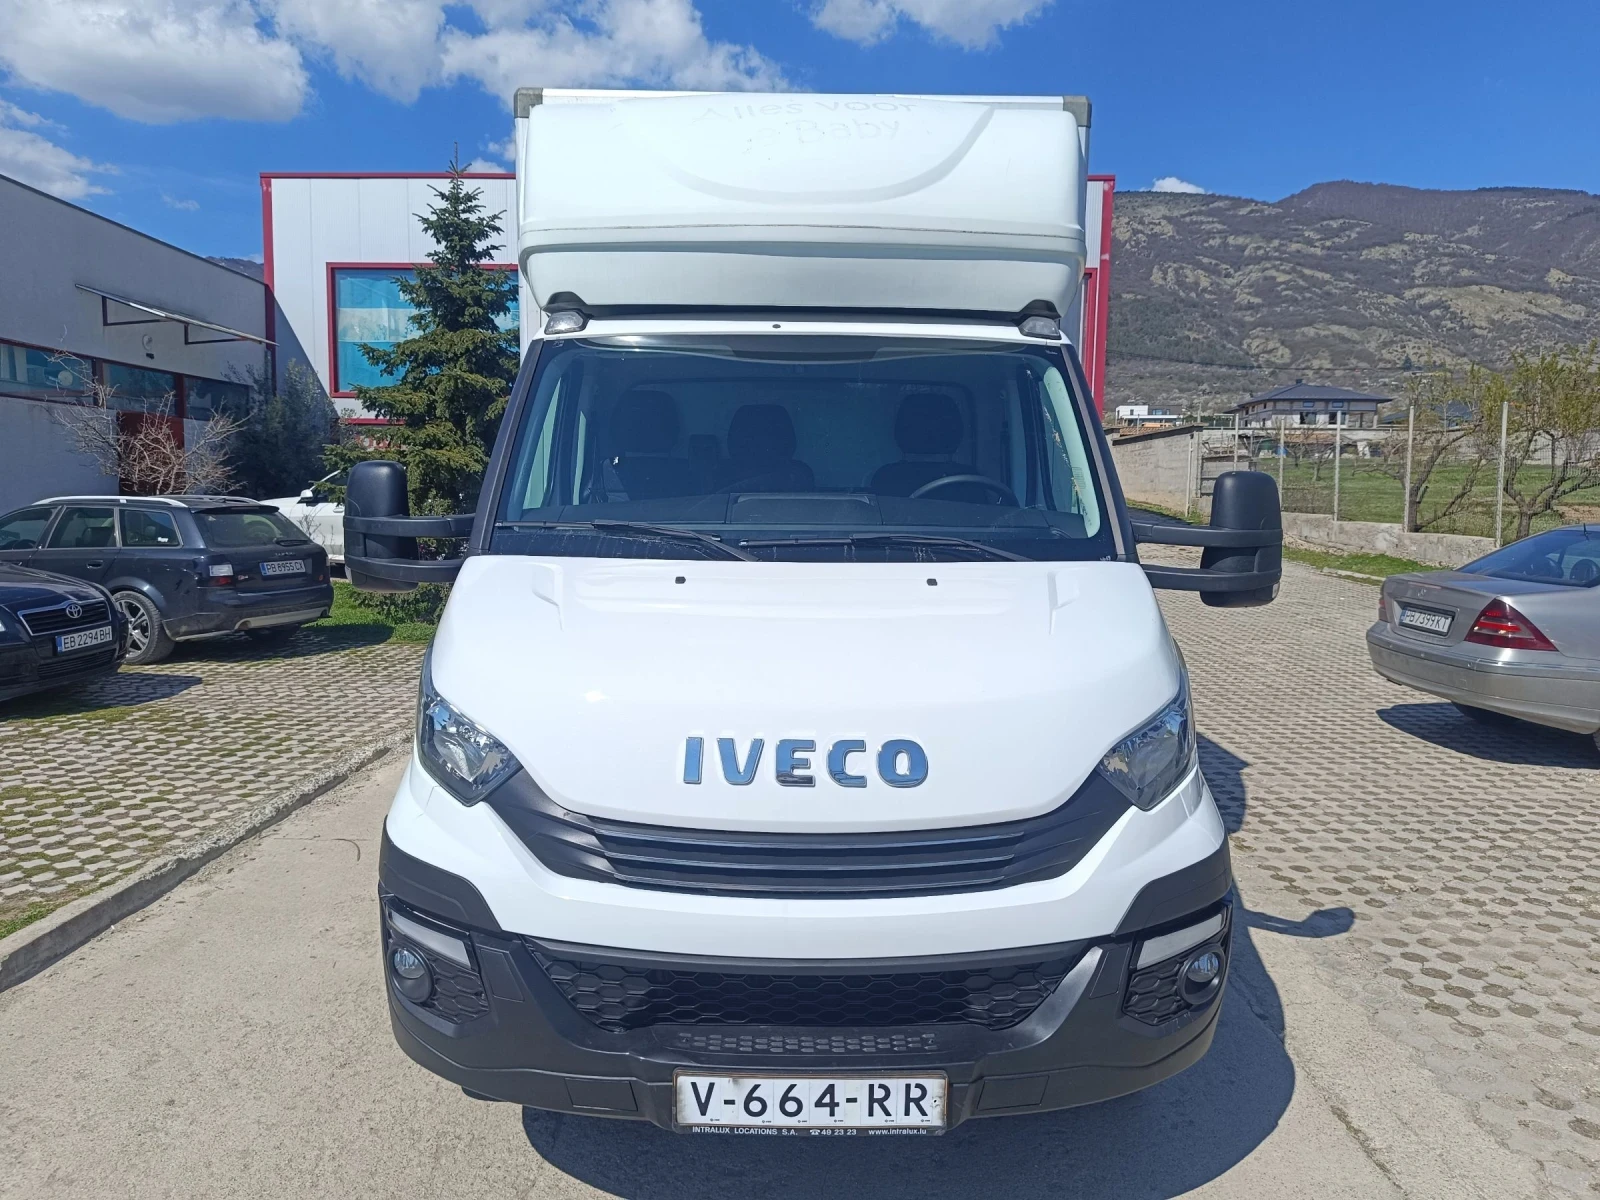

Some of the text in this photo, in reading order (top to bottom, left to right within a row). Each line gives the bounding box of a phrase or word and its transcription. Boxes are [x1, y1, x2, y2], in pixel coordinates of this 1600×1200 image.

[684, 736, 929, 788] IVECO
[690, 1081, 929, 1118] V-664-RR
[692, 1126, 730, 1134] INTRALUX
[734, 1127, 778, 1135] LOCATIONS
[781, 1128, 798, 1136] S.A.
[868, 1127, 927, 1135] www.intralux.lu
